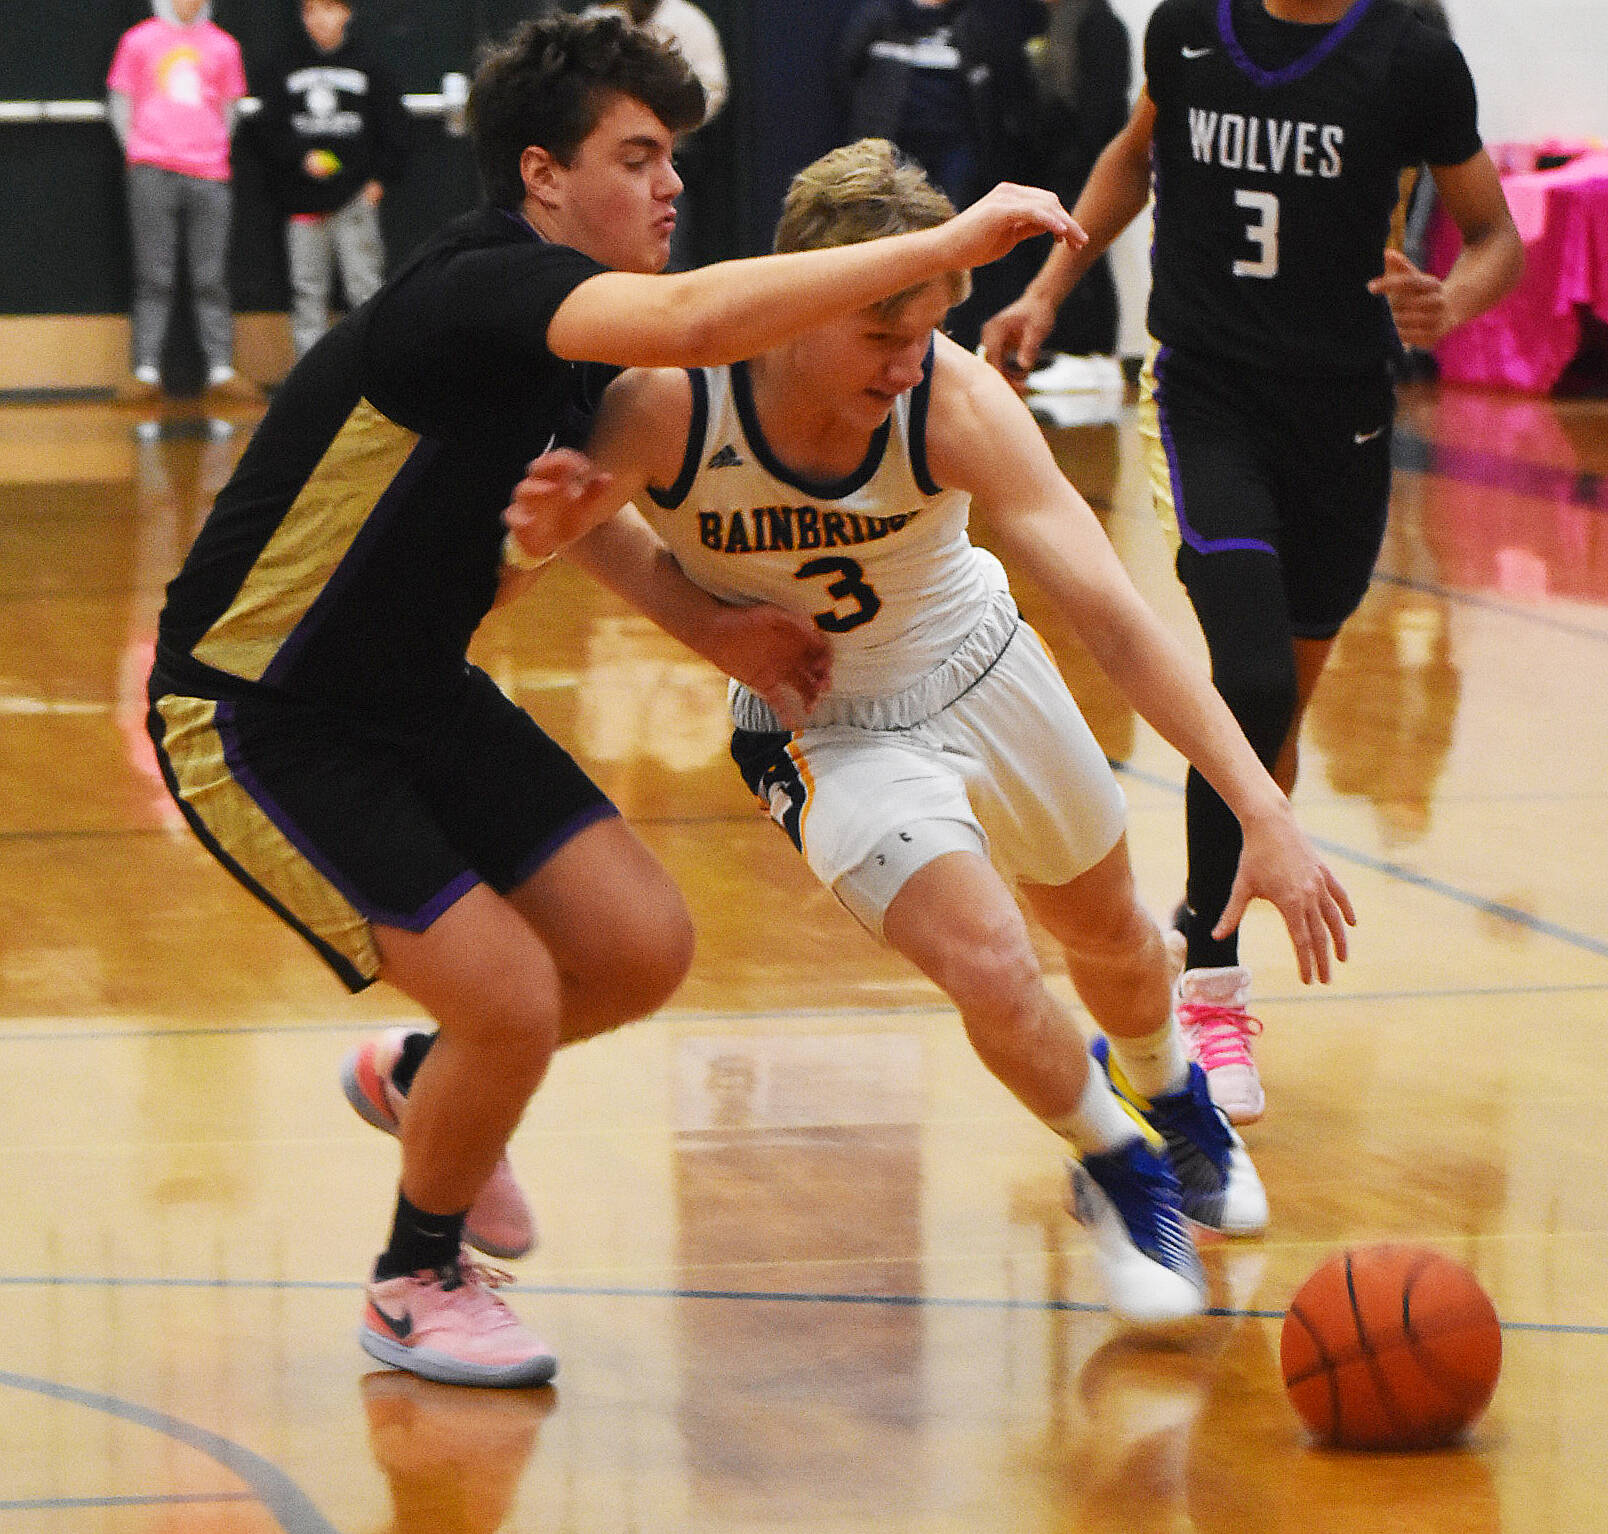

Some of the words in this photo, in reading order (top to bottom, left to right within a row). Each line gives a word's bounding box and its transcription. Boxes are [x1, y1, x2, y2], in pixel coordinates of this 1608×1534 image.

[1188, 106, 1344, 178] WOLVES
[1232, 189, 1280, 279] 3
[699, 506, 922, 553] BAINBRID
[794, 556, 882, 633] 3
